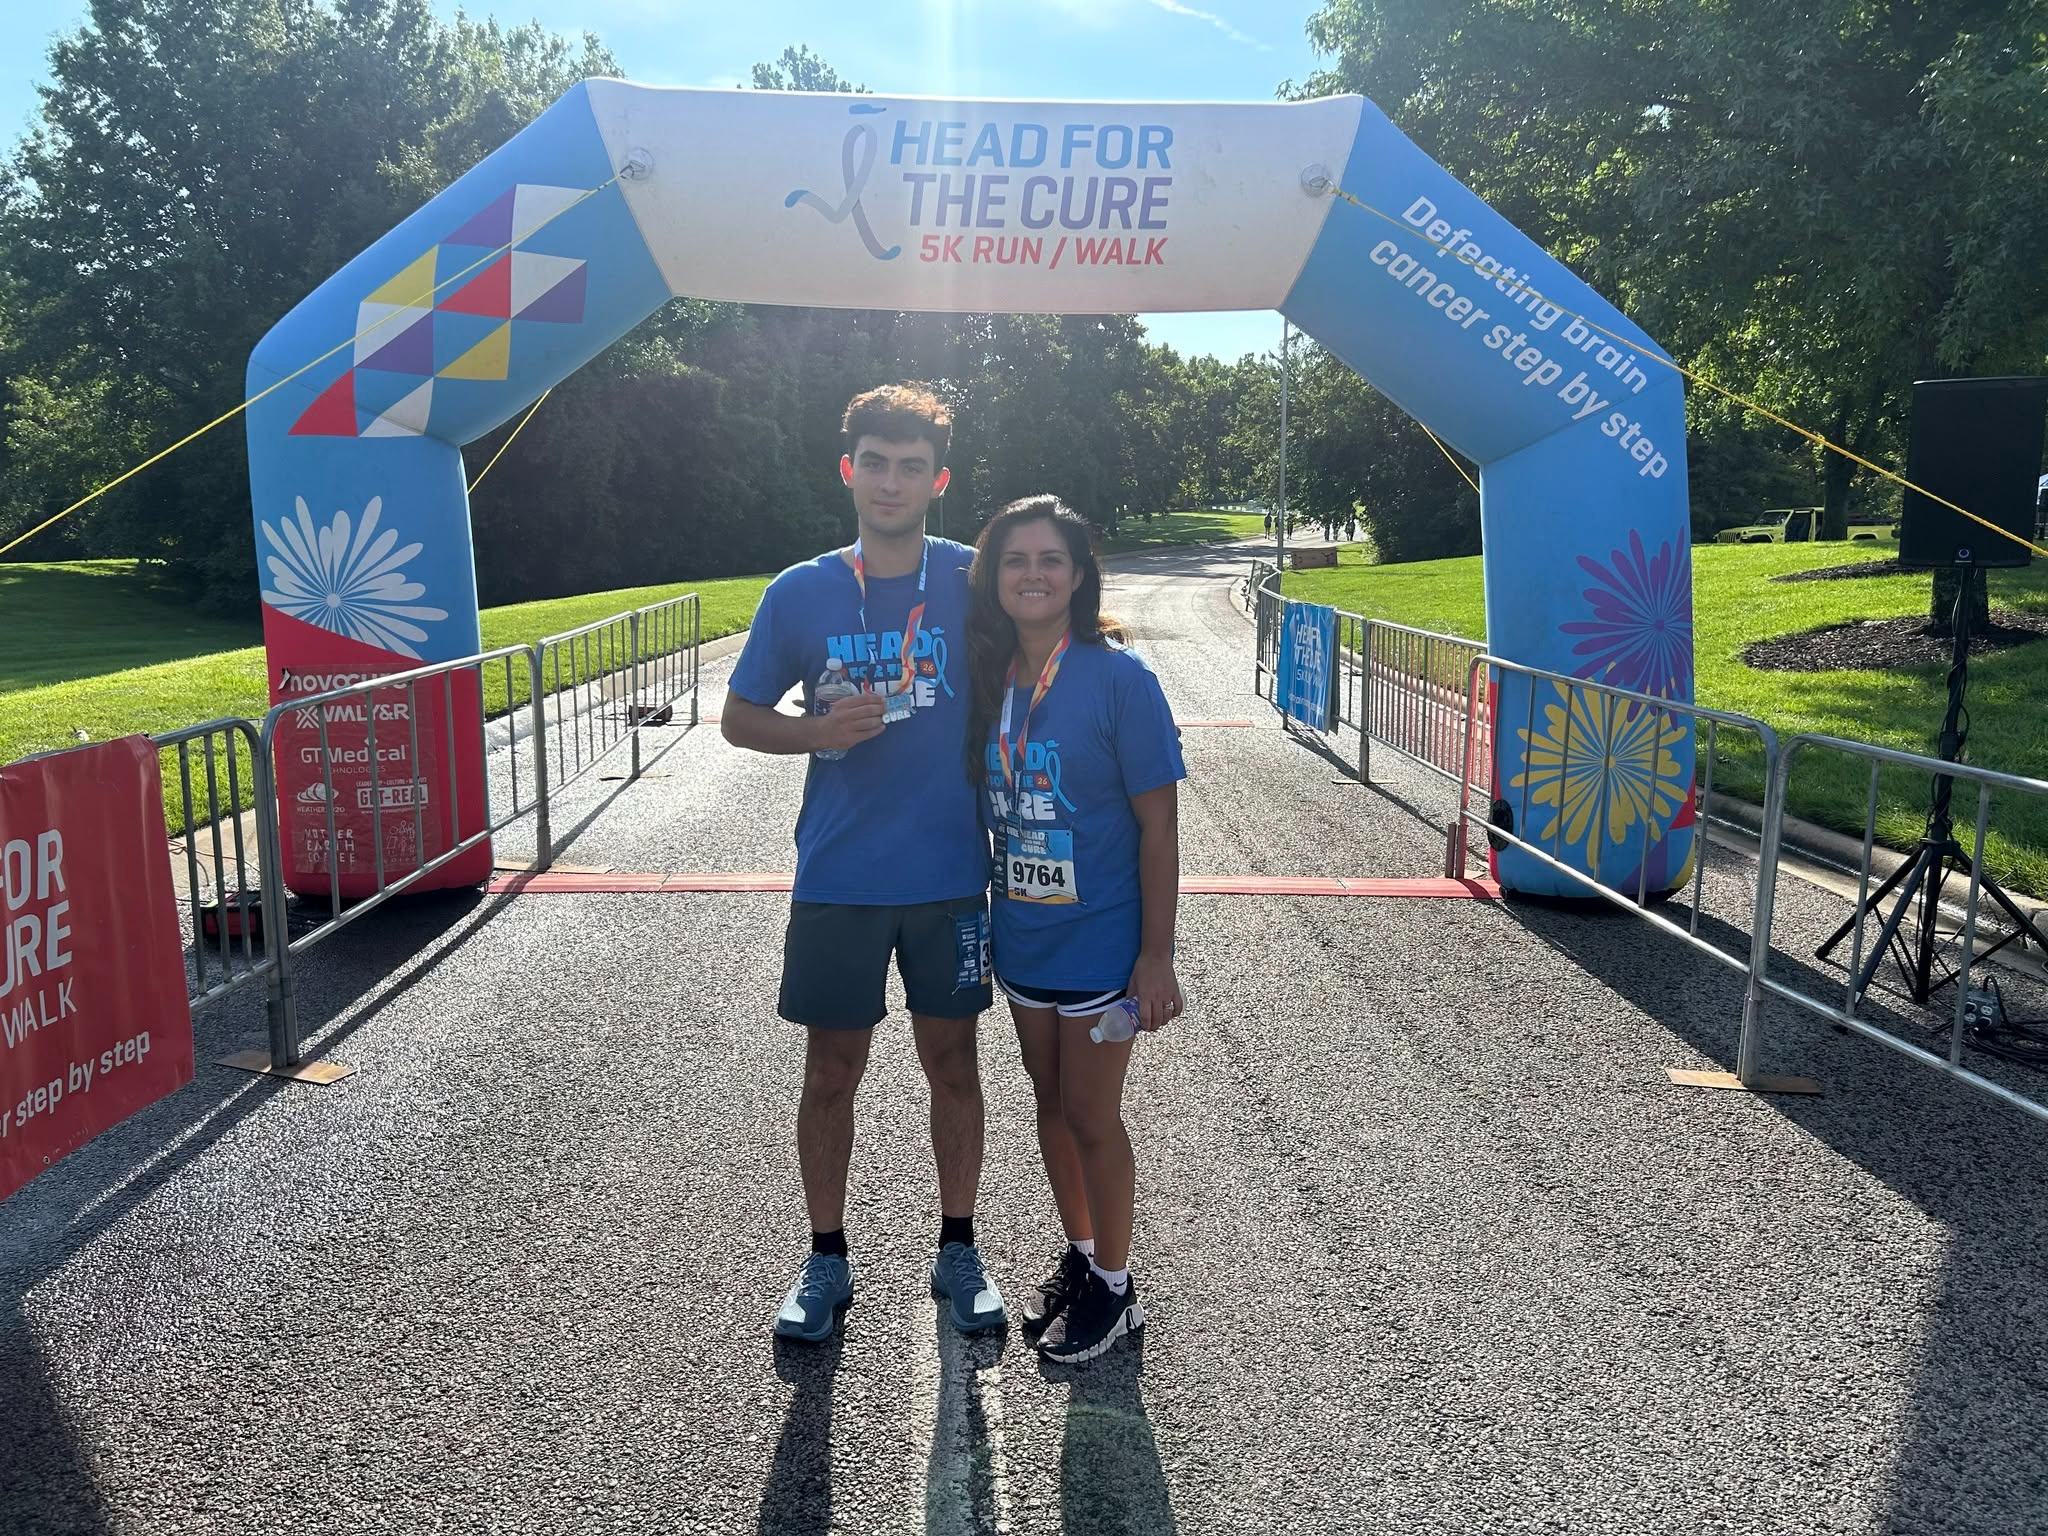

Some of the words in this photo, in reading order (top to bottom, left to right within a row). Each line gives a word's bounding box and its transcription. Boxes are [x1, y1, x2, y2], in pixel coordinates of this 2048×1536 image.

[889, 119, 1049, 168] HEAD
[1060, 123, 1174, 170] FOR
[902, 172, 1010, 229] THE
[1020, 175, 1173, 230] CURE
[919, 234, 964, 263] 5K
[972, 235, 1043, 265] RUN
[1075, 236, 1169, 266] WALK
[1401, 195, 1564, 332] Defeating
[1560, 315, 1648, 395] brain
[1368, 240, 1490, 330] cancer
[1482, 324, 1563, 387] step
[1556, 372, 1609, 421] by
[1600, 412, 1669, 480] step
[300, 747, 323, 764] GT
[326, 744, 406, 764] Medcal
[304, 828, 354, 840] MOTER
[0, 828, 66, 911] OR
[1012, 860, 1066, 888] 9764
[2, 976, 78, 1050] WALK
[15, 1077, 63, 1128] step
[68, 1057, 96, 1094] by
[100, 1030, 152, 1076] step
